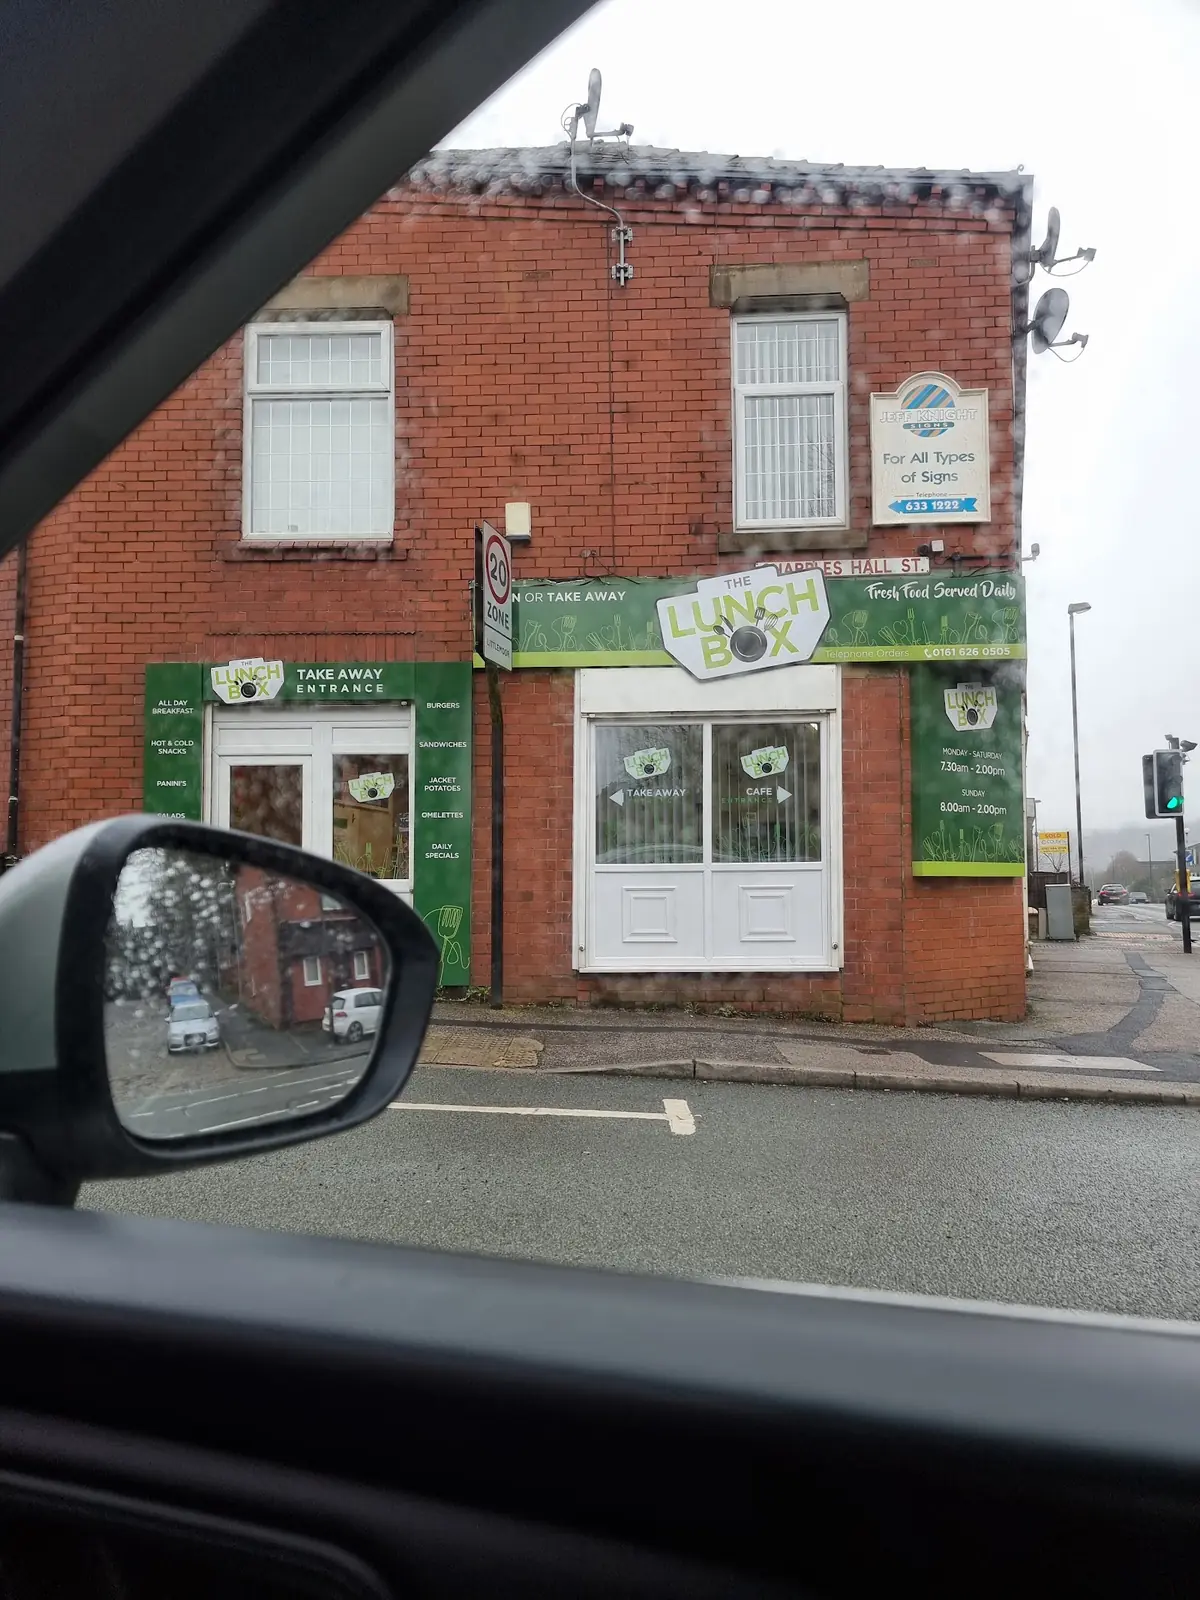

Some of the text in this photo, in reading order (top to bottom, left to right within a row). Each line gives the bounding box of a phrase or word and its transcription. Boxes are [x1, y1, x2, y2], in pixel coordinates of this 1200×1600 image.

[880, 408, 978, 424] JEFF KNIGHT
[883, 451, 975, 465] For All Types
[901, 471, 958, 485] of Signs
[905, 500, 960, 511] 633 1222
[490, 552, 507, 588] 20
[851, 559, 892, 574] HALL
[901, 558, 925, 572] ST.
[724, 575, 752, 590] THE
[524, 592, 543, 602] OR
[547, 592, 581, 602] TAKE
[584, 591, 626, 601] AWAY
[864, 580, 1017, 601] Fresh Food Served Daily
[487, 600, 510, 630] ZONE
[667, 578, 819, 639] LUNCH
[825, 647, 1011, 659] Telephone Orders 0161 626 0505
[215, 664, 280, 685] LUNCH
[296, 668, 383, 680] TAKE AWAY
[296, 684, 384, 693] ENTRANCE
[947, 690, 995, 710] LUNCH
[626, 750, 669, 768] LUNCH
[743, 748, 786, 768] LUNCH
[942, 747, 968, 757] MONDAY
[972, 750, 1003, 760] SATURDAY
[940, 761, 969, 773] 7.30am
[975, 764, 1006, 777] 2.00pm
[351, 776, 392, 790] LUNCH
[627, 788, 686, 797] TAKE AWAY
[746, 787, 773, 796] CAFE
[961, 788, 985, 797] SUNDAY
[940, 801, 970, 813] 8.00am
[977, 803, 1007, 816] 2.00pm
